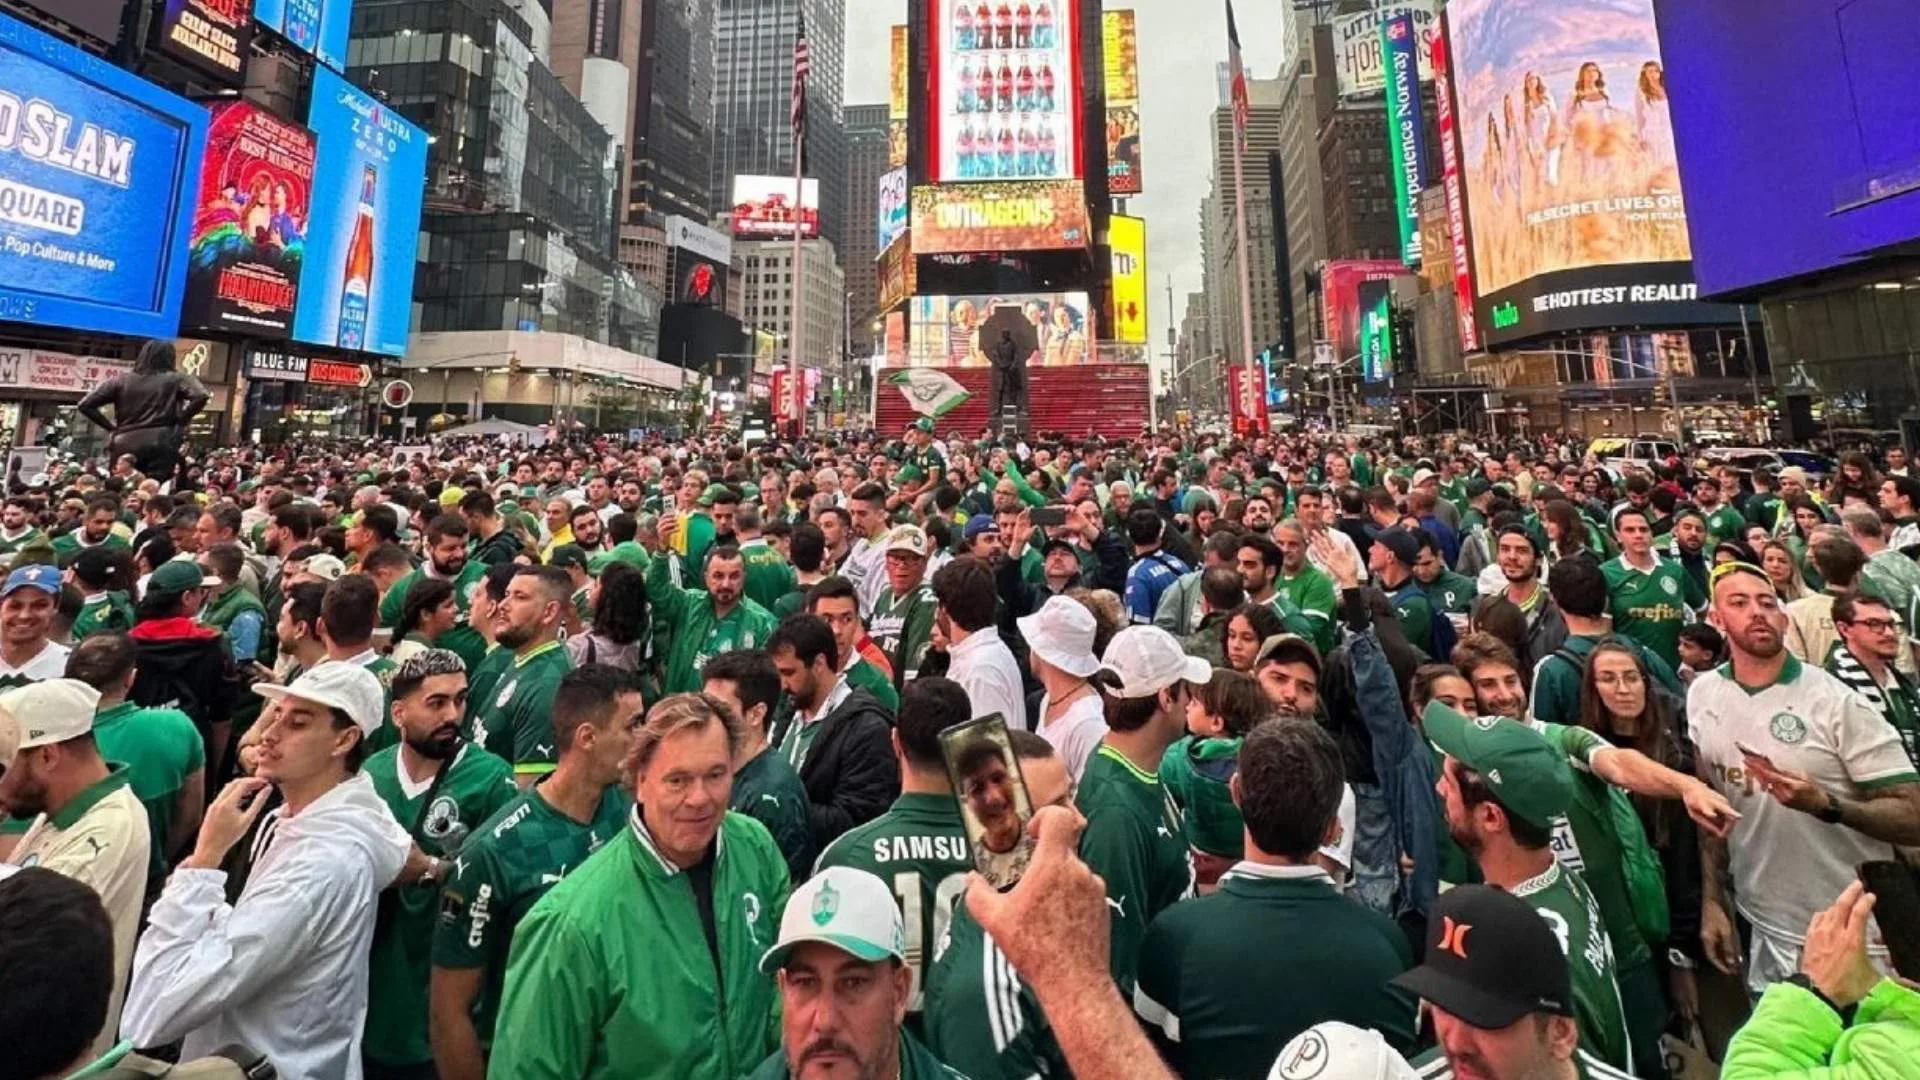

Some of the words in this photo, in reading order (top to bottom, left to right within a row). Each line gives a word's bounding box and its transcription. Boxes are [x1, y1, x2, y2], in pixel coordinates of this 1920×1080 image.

[1343, 10, 1391, 41] LITTLE
[1392, 50, 1412, 118] Norway
[1400, 119, 1423, 218] Experience
[937, 199, 1054, 229] OUTRAGEOUS
[1604, 196, 1653, 211] LIVES
[5, 235, 31, 257] Pop
[32, 242, 75, 265] Culture
[76, 251, 86, 266] &
[87, 253, 116, 272] More
[1550, 286, 1627, 309] HOTTEST
[253, 351, 285, 370] BLUE
[287, 355, 308, 372] FIN
[873, 835, 968, 863] SAMSU
[464, 883, 492, 948] crefisa
